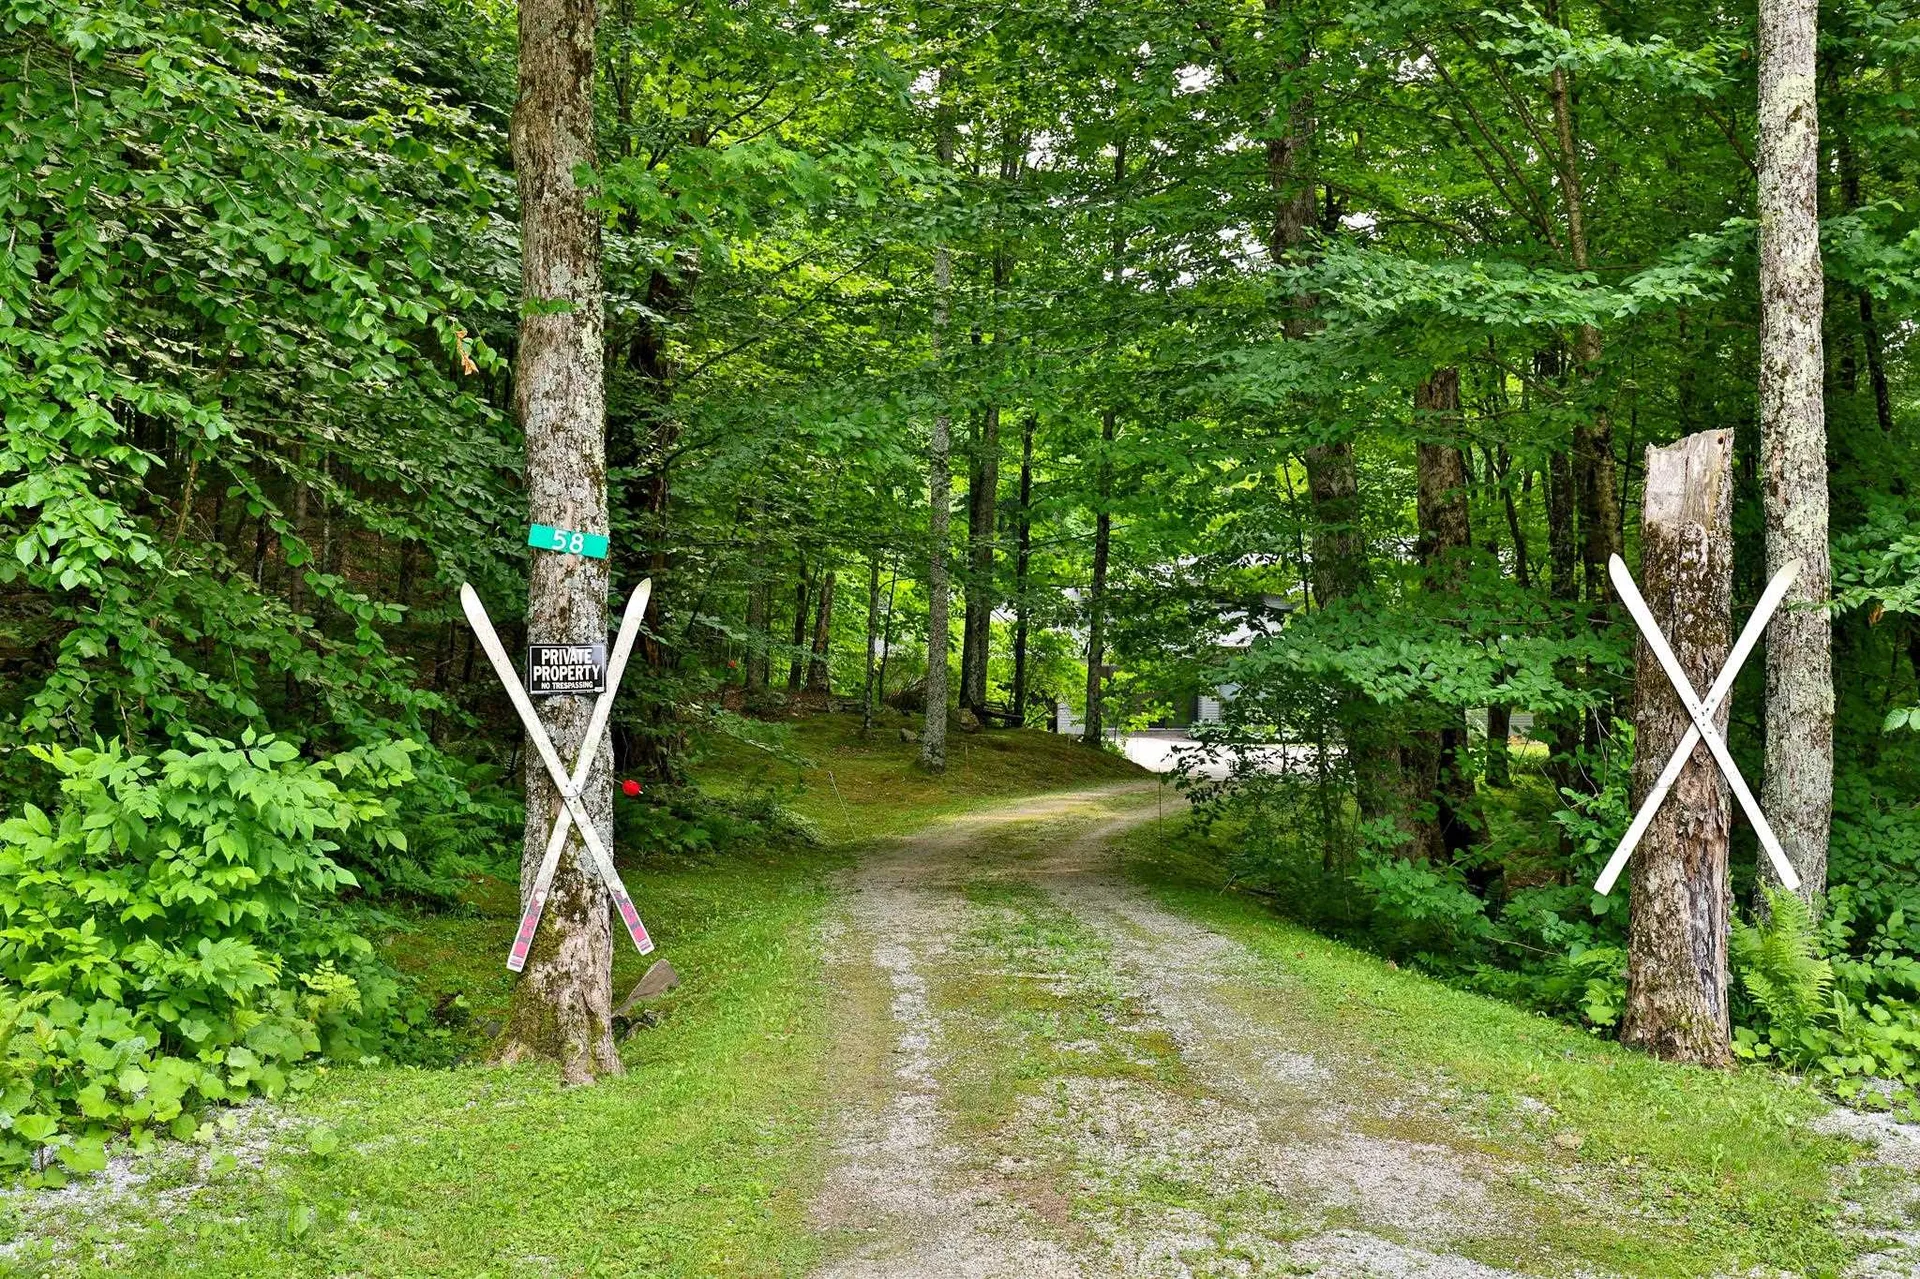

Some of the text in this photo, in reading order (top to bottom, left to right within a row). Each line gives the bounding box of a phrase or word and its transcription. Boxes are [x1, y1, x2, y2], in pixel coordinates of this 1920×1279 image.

[552, 529, 584, 553] 58
[541, 648, 592, 664] PRIVATE
[533, 665, 600, 681] PROPERTY
[552, 681, 593, 689] TRESPASSING
